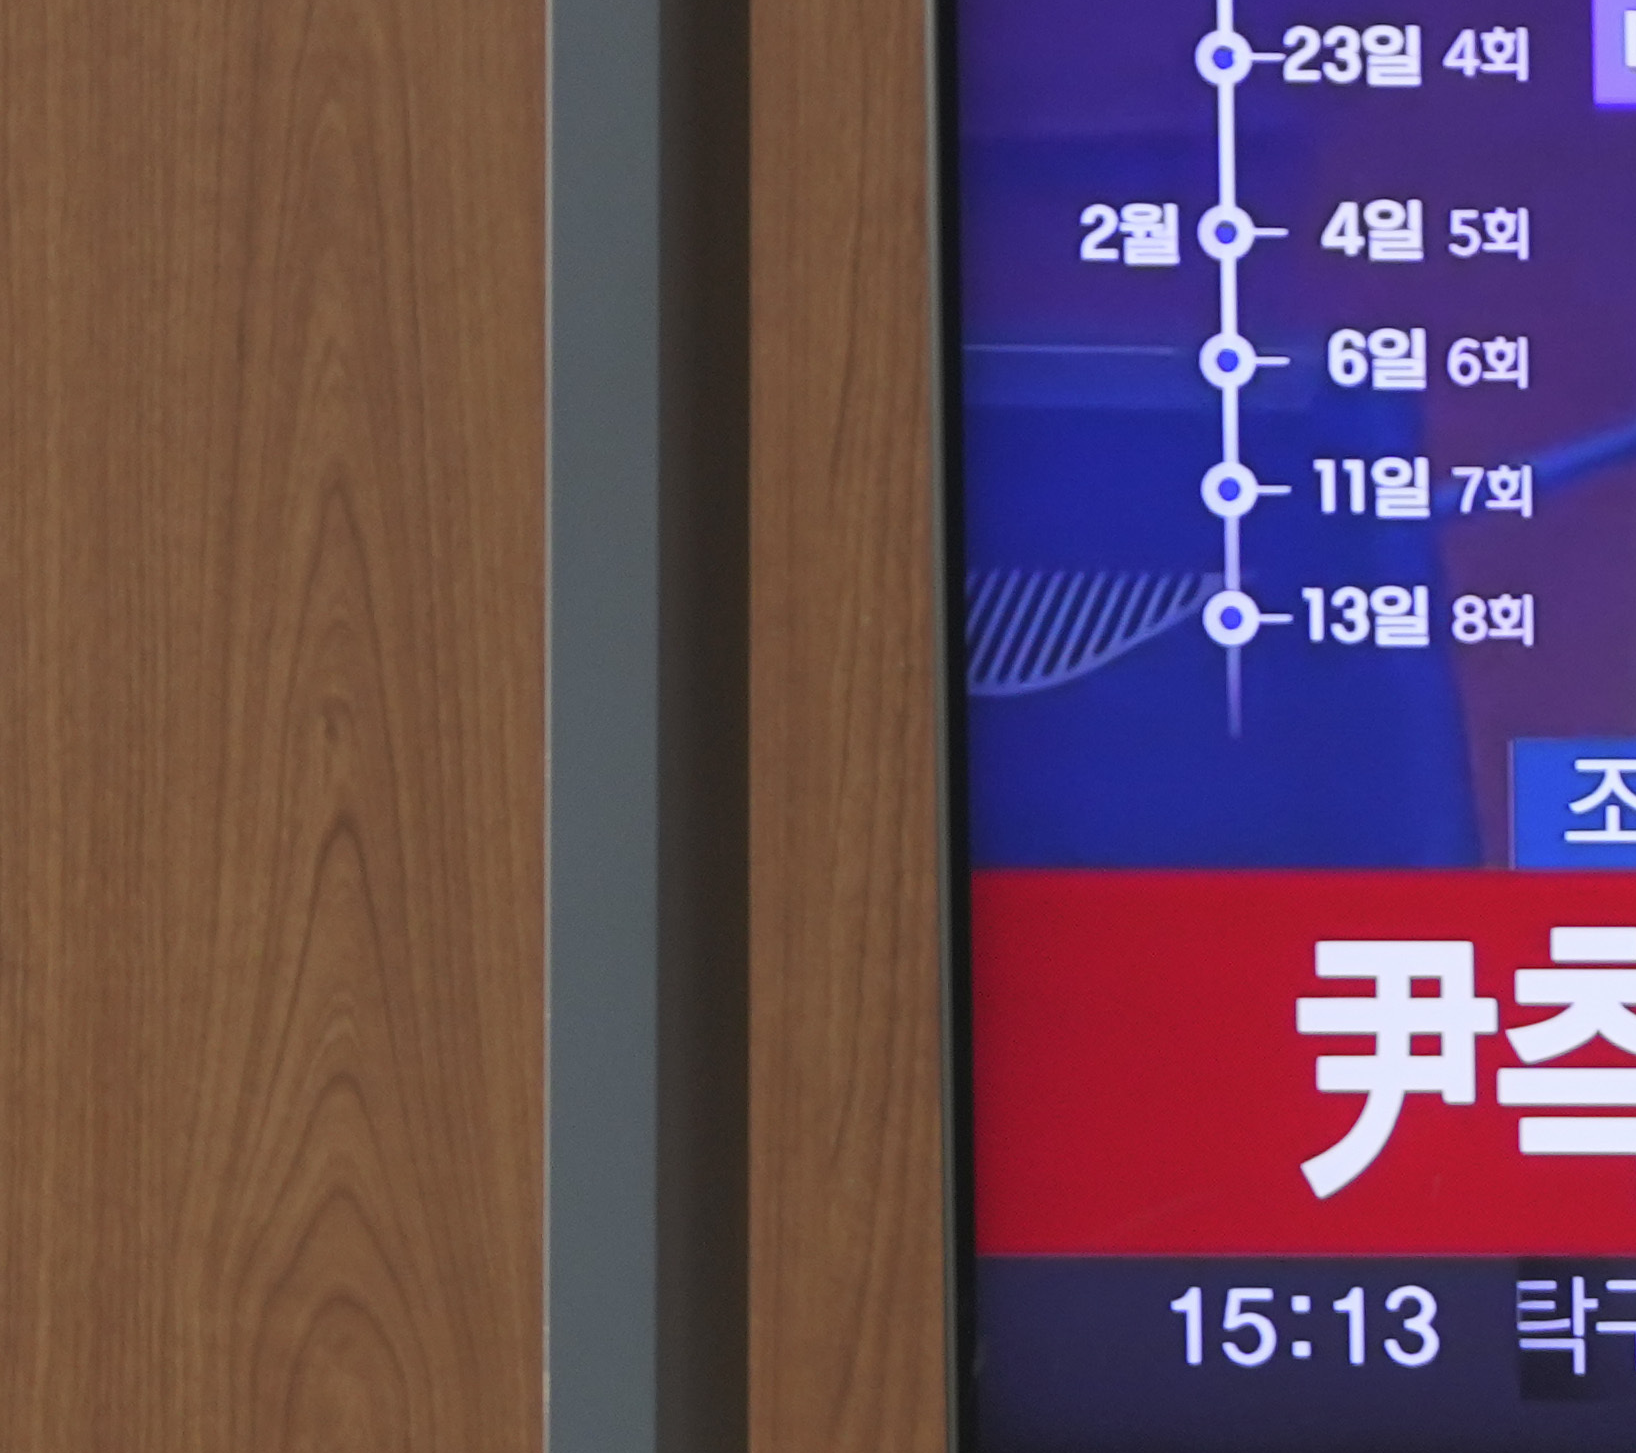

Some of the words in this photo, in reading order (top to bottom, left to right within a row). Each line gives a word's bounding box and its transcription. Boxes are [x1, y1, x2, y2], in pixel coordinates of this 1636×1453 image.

[1283, 24, 1422, 87] 23일
[1442, 26, 1529, 82] 4회
[1080, 202, 1181, 266] 2월
[1320, 199, 1424, 262] 4일
[1448, 206, 1529, 261] 5회
[1328, 327, 1427, 390] 6일
[1447, 336, 1529, 390] 6회
[1313, 456, 1431, 519] 11일
[1452, 464, 1533, 518] 7회
[1301, 585, 1430, 648] 13일
[1452, 593, 1534, 647] 8회
[1170, 1285, 1440, 1367] 15:13
